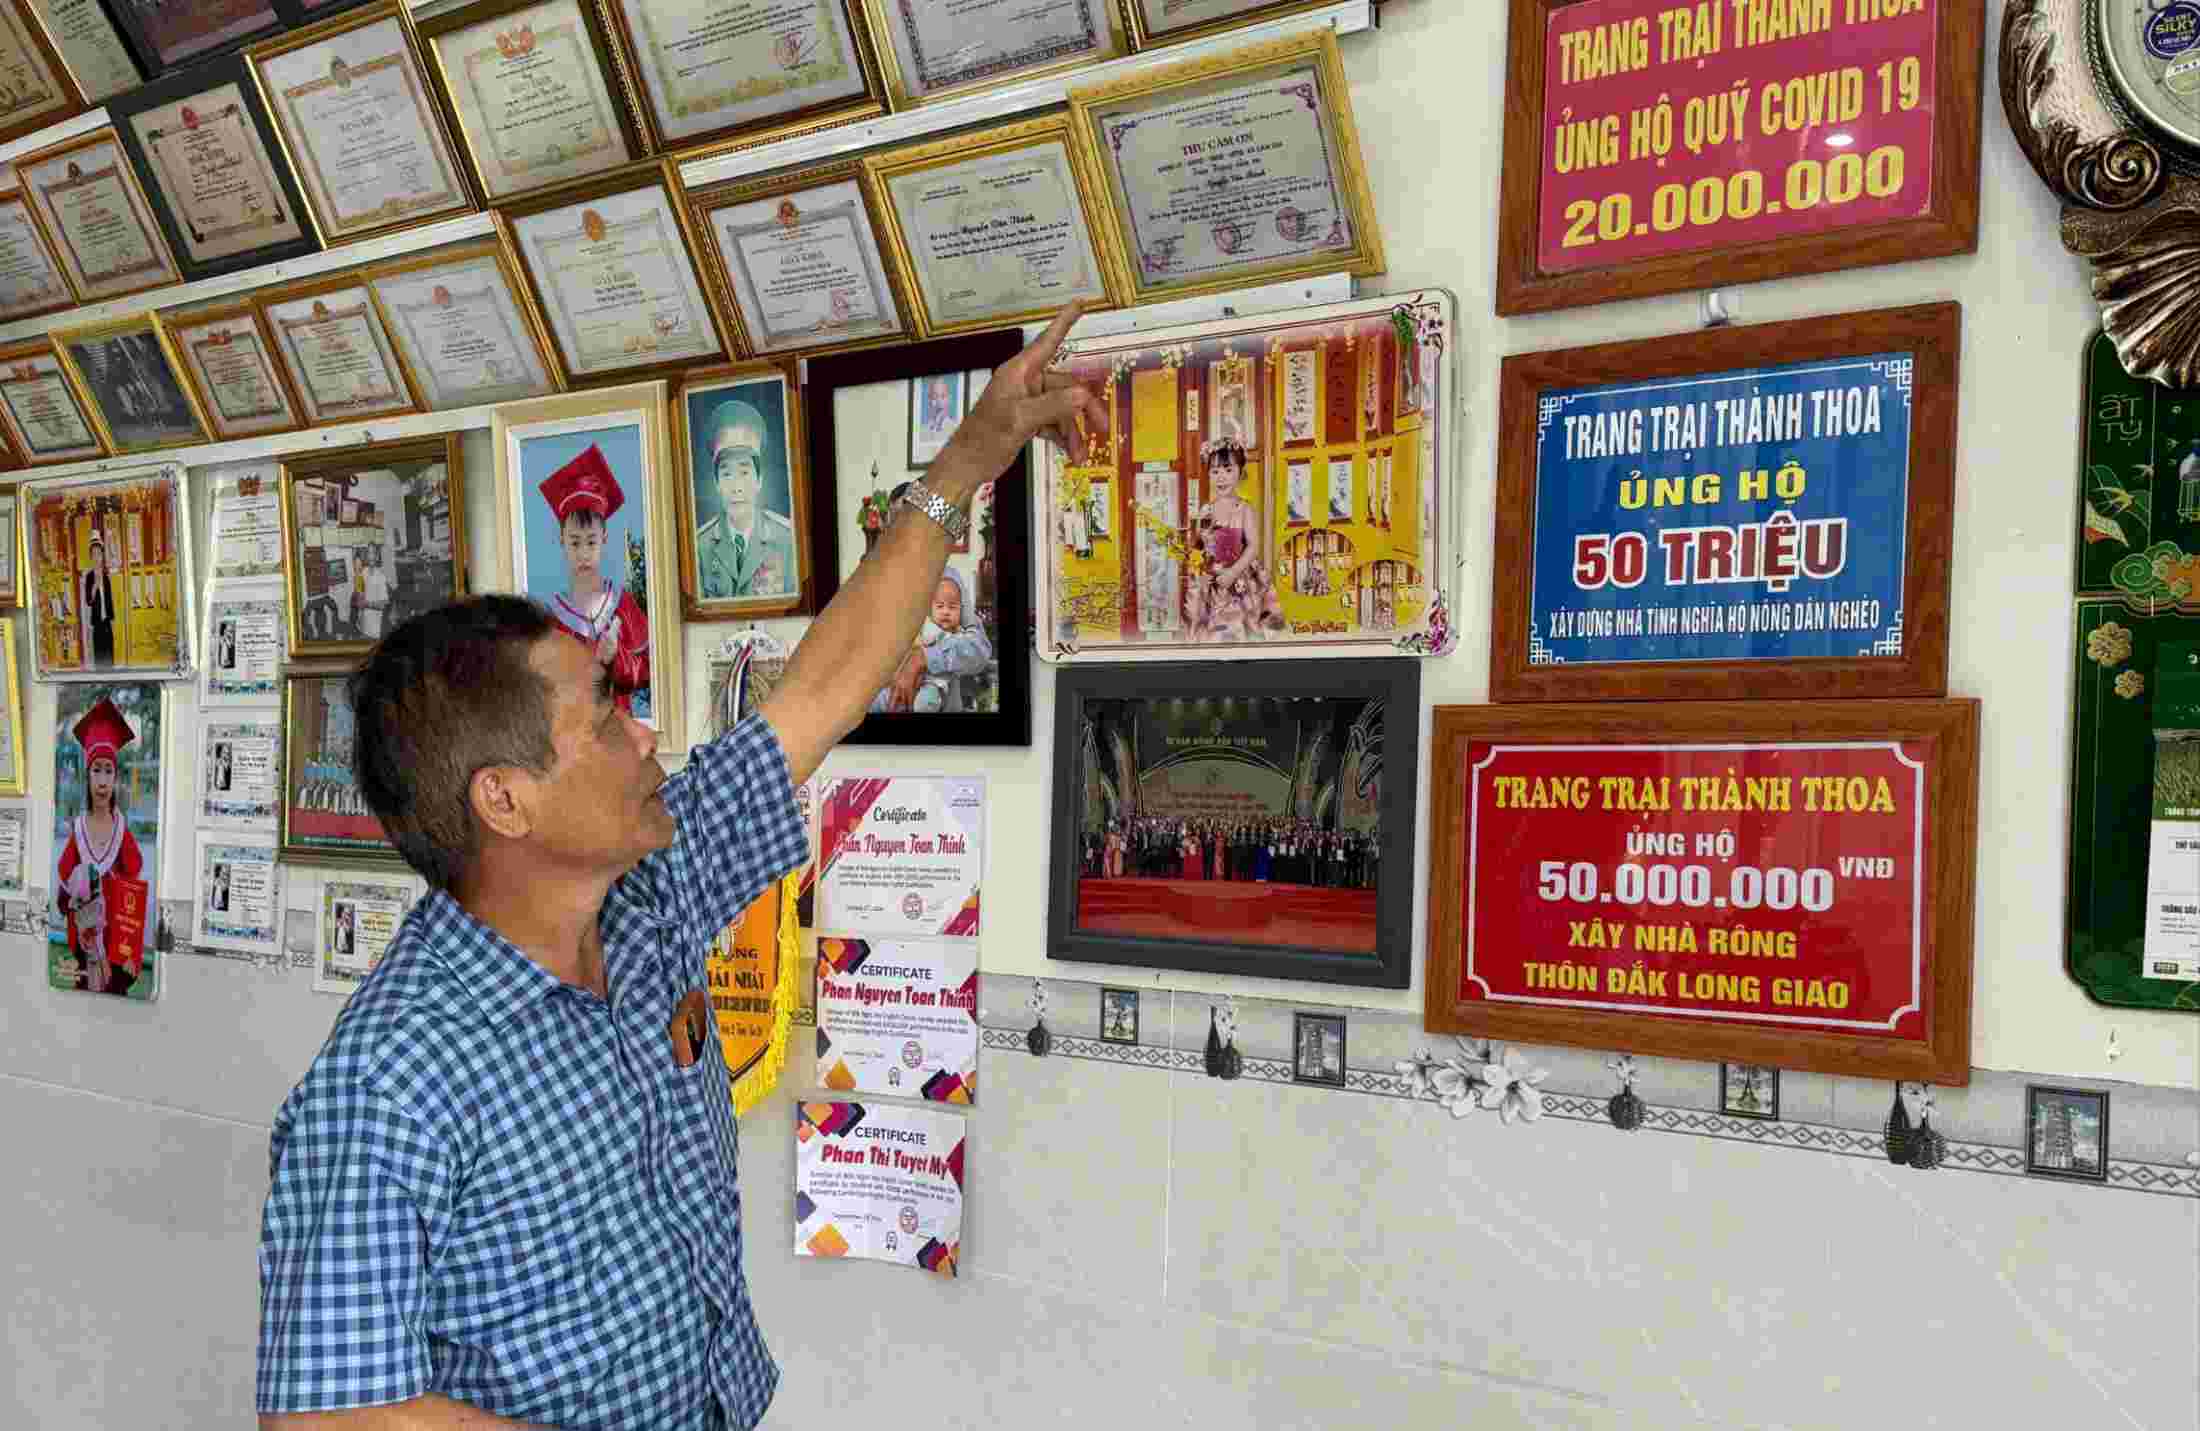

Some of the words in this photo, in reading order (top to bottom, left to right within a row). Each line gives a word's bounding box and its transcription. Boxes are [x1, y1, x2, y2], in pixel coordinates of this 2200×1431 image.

[1559, 16, 1649, 85] TRANG
[1657, 0, 1722, 69] TRẠI
[1555, 106, 1620, 173] ỦNG
[1630, 93, 1671, 166] HỘ
[1684, 78, 1751, 154] QUỸ
[1760, 66, 1864, 134] COVID
[1877, 56, 1921, 113] 19
[1561, 145, 1905, 248] 20.000.000
[1564, 406, 1642, 460] TRANG
[1651, 401, 1706, 460] TRẠI
[1715, 386, 1802, 448] THÀNH
[1811, 384, 1881, 438] THOA
[1618, 470, 1721, 510] ỦNG
[1738, 461, 1806, 505] HỘ
[1573, 531, 1648, 590] 50
[1658, 510, 1849, 593] TRIỆU
[1550, 605, 1576, 639] XÂY
[1577, 607, 1613, 643] DỰNG
[1728, 600, 1746, 639] HỘ
[1794, 596, 1825, 631] DÂN
[1494, 776, 1592, 811] TRANG
[1599, 776, 1671, 821] TRẠI
[1680, 768, 1793, 813] THÀNH
[1800, 774, 1897, 814] THOA
[1626, 825, 1686, 857] ỦNG
[1696, 827, 1736, 863] HỘ
[1538, 860, 1835, 912] 50.000.000
[1838, 855, 1895, 880] VNĐ
[1569, 917, 1624, 948] XÂY
[1635, 918, 1698, 954] NHÀ
[1708, 922, 1797, 959] RÔNG
[860, 965, 934, 980] CERTIFICATE
[1523, 959, 1597, 993] THÔN
[1606, 959, 1667, 998] ĐẮK
[1678, 974, 1760, 1006] LONG
[1772, 976, 1850, 1010] GIAO
[821, 1144, 865, 1165] Phan
[855, 1126, 928, 1146] CERTIFICATE
